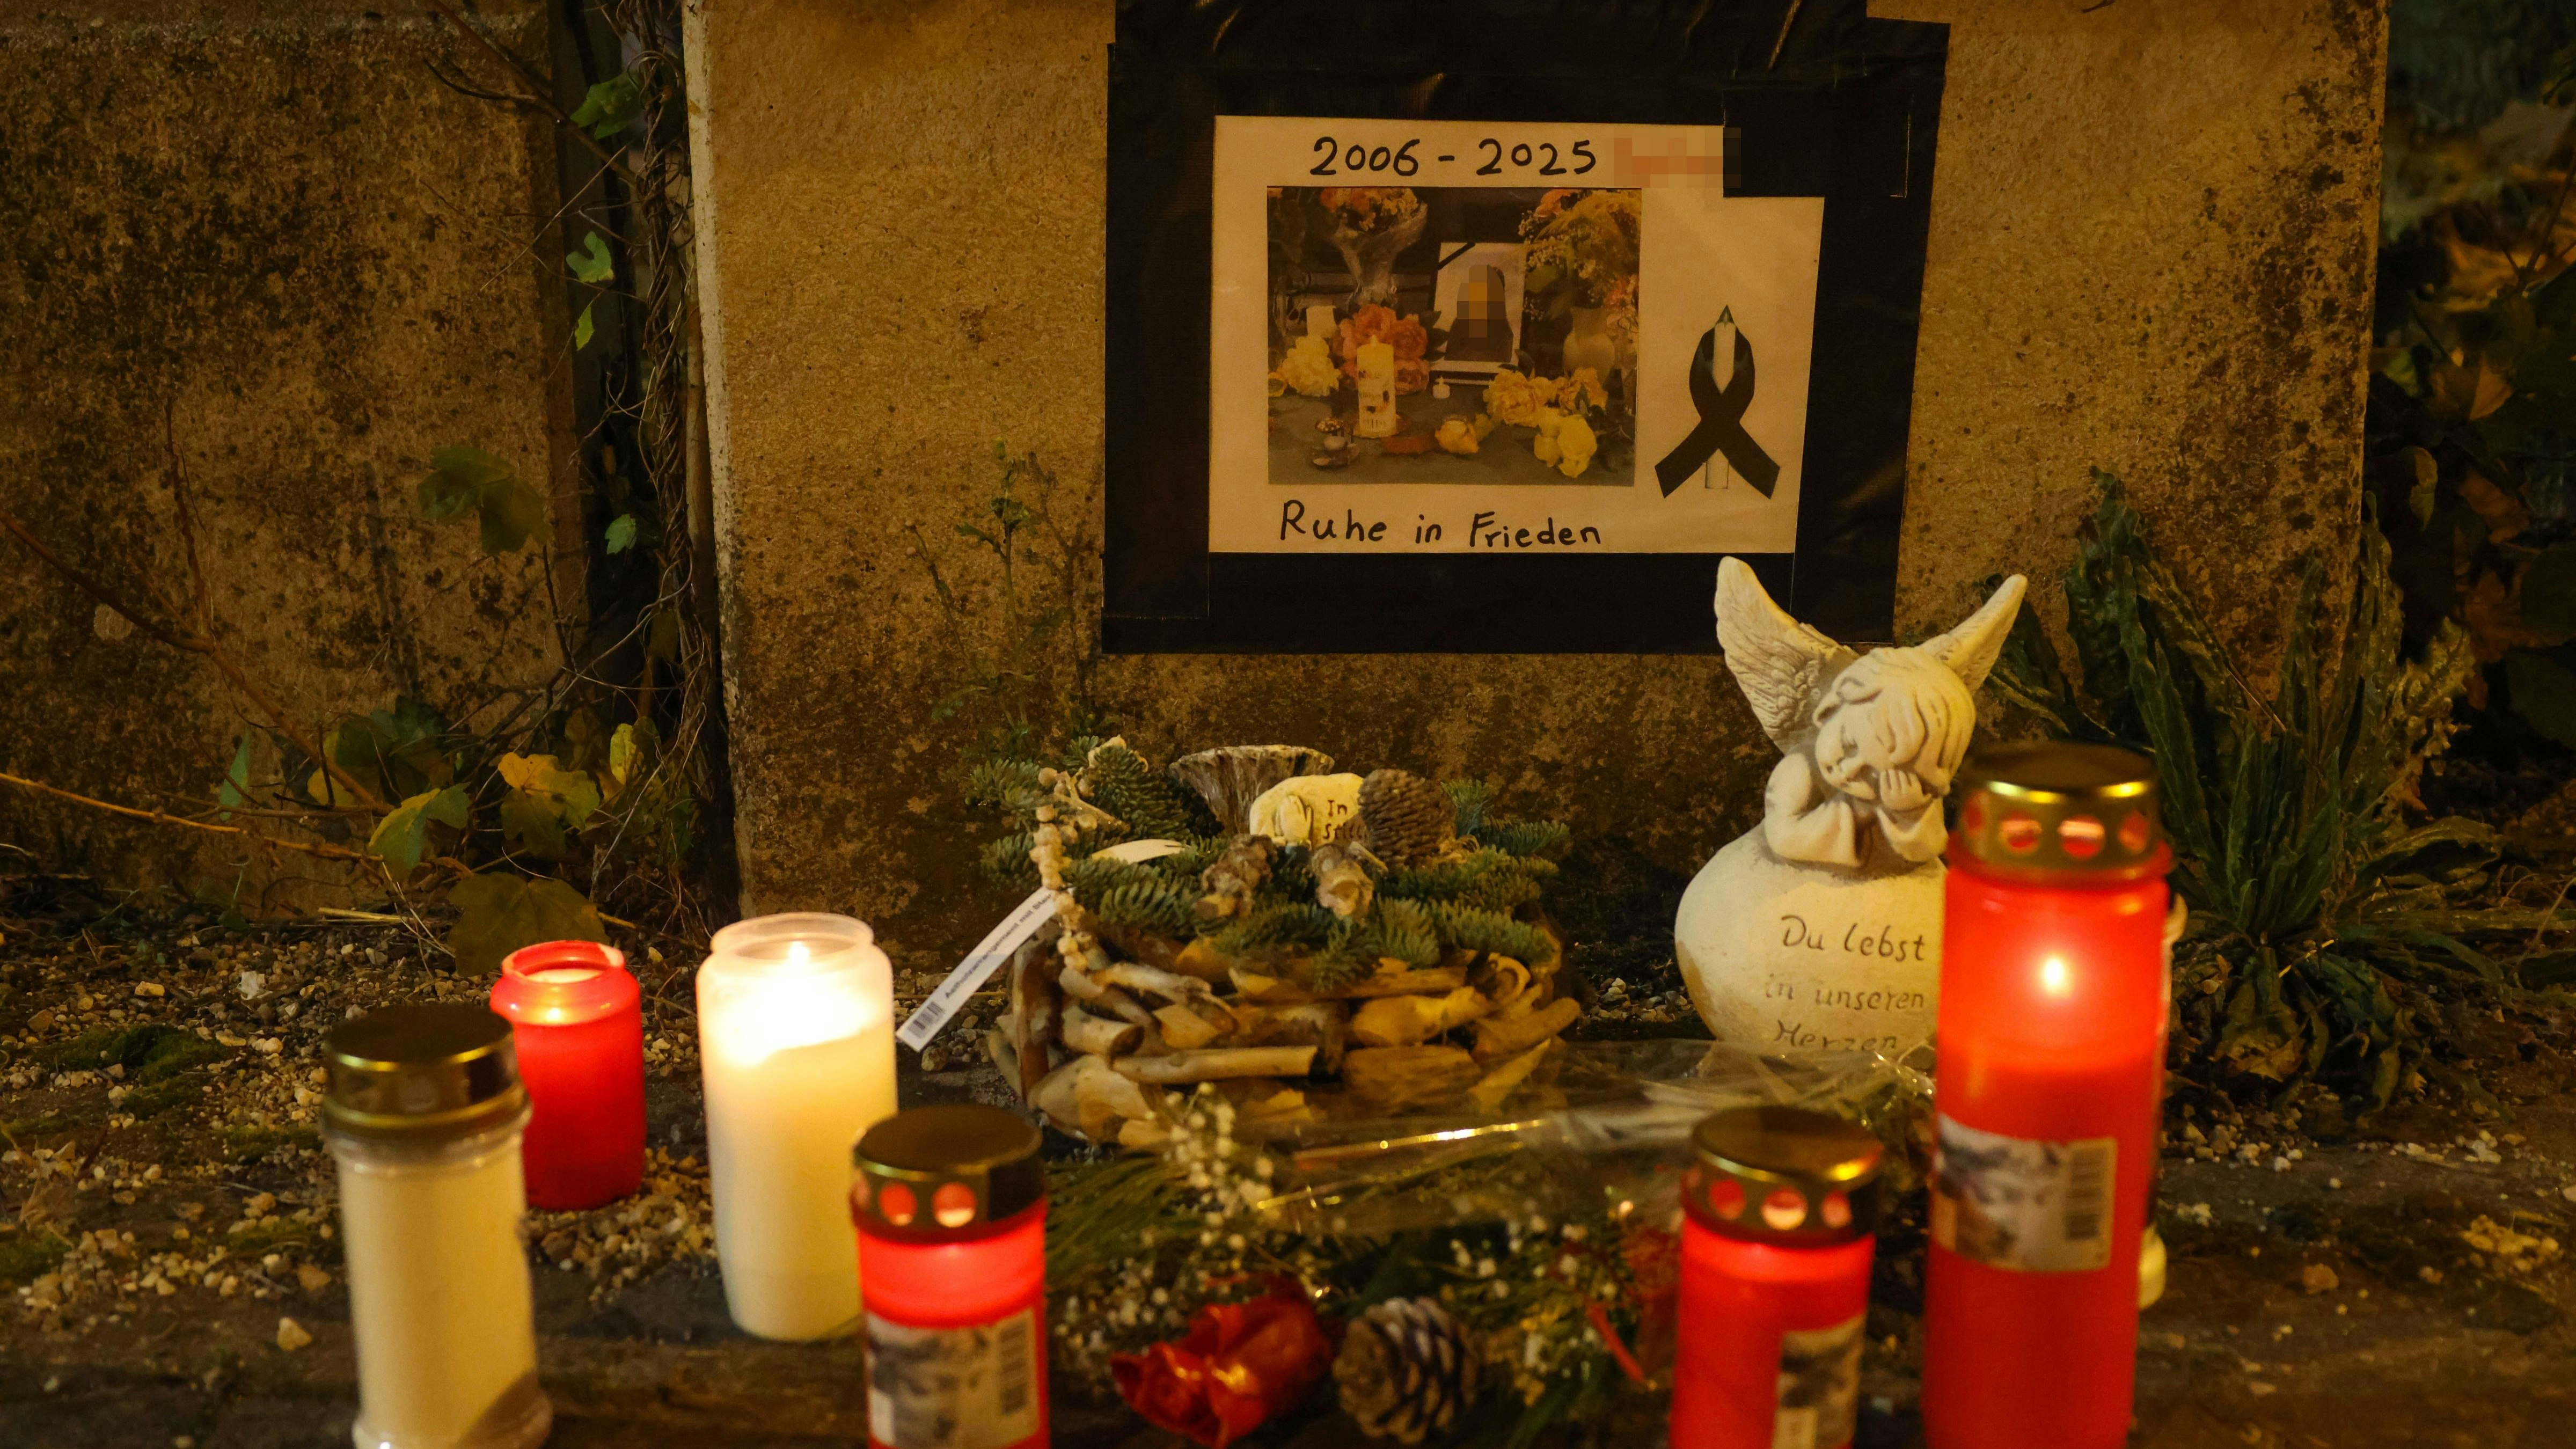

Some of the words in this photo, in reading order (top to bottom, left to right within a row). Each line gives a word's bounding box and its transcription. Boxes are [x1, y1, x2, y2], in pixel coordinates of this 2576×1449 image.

[1309, 136, 1420, 177] 2006
[1475, 137, 1597, 175] 2025
[1280, 499, 1388, 542] Ruhe
[1415, 514, 1442, 544] in
[1469, 510, 1601, 548] Frieden
[1327, 799, 1348, 817] In
[1781, 914, 1825, 951] Du
[1843, 923, 1925, 962] lebst
[1766, 972, 1794, 1000] in
[1815, 985, 1924, 1011] unseren
[1773, 1020, 1898, 1051] Herzen
